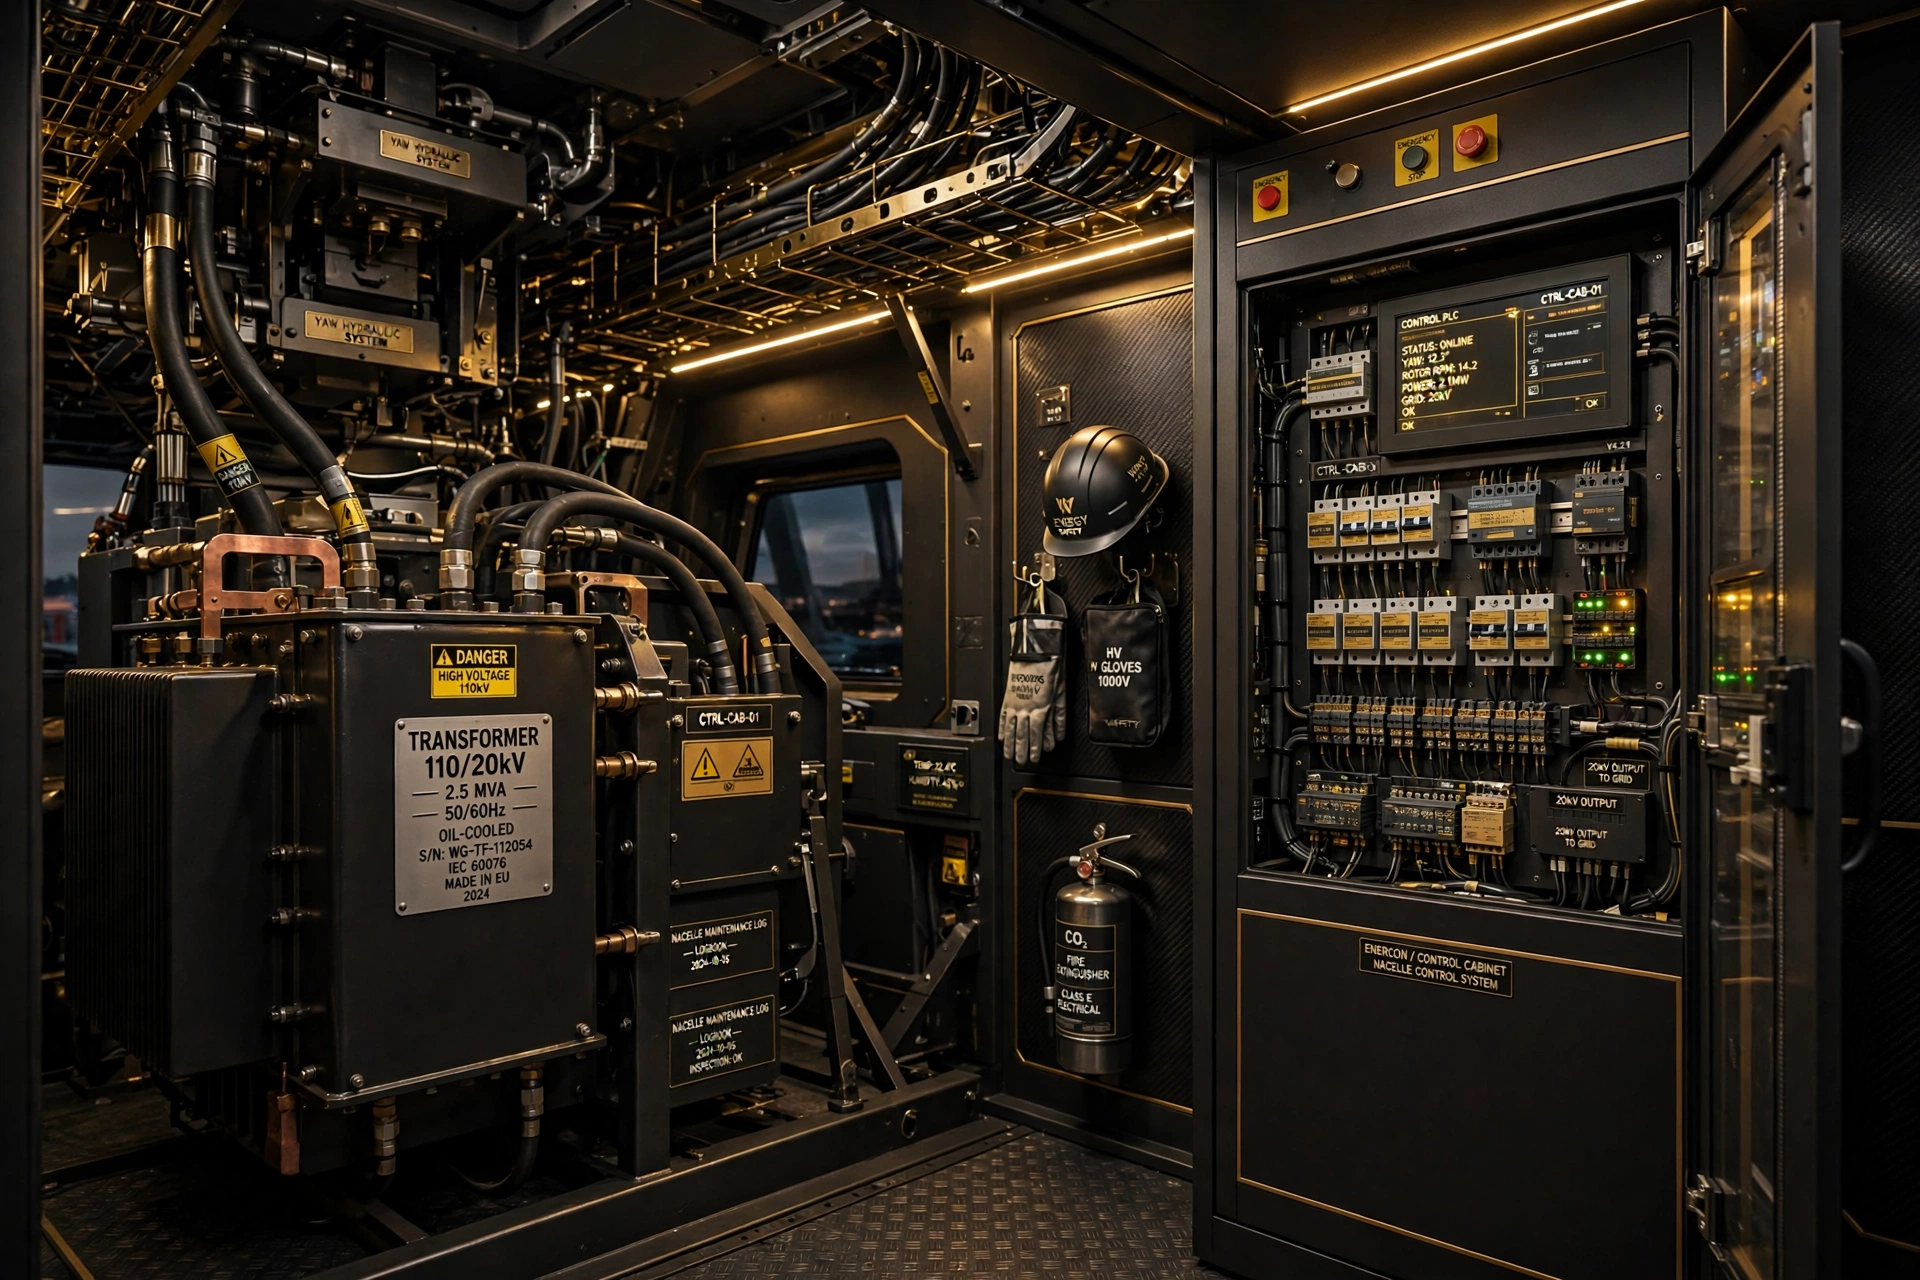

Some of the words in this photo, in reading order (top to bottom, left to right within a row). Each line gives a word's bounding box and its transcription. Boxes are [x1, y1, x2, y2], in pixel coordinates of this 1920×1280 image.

[315, 316, 337, 328] YAW
[1401, 314, 1441, 329] CONTROL
[1443, 311, 1459, 322] PLC
[1402, 342, 1438, 356] STATUS:
[1440, 335, 1474, 350] ONLINE
[1458, 361, 1478, 373] 14.2
[1401, 406, 1415, 417] OK
[1586, 399, 1599, 408] OK
[456, 649, 509, 665] DANGER
[1106, 647, 1122, 659] HV
[1101, 661, 1142, 673] GLOVES
[438, 670, 463, 682] HIGH
[466, 670, 510, 682] VOLTAGE
[1098, 675, 1131, 687] 1000V
[459, 683, 490, 694] 110kV
[699, 711, 759, 727] CTRL-CAB-01
[408, 726, 539, 751] TRANSFORMER
[425, 751, 526, 779] 110/20kV
[1611, 763, 1645, 774] OUTPUT
[1599, 773, 1611, 783] TO
[445, 784, 469, 800] 2.5
[474, 781, 507, 798] MVA
[1555, 794, 1579, 806] 20kV
[1580, 797, 1618, 809] OUTPUT
[445, 802, 506, 821] 50/60Hz
[439, 822, 514, 843] OIL-COOLED
[419, 849, 445, 863] S/N:
[449, 838, 533, 859] WG-TF-112054
[1565, 838, 1576, 847] TO
[448, 861, 467, 874] IEC
[471, 857, 507, 872] 60076
[444, 876, 477, 890] MADE
[480, 873, 492, 886] IN
[495, 871, 510, 884] EU
[463, 888, 490, 902] 2024
[671, 928, 703, 944] NACELLE
[753, 918, 768, 929] LOG
[1364, 943, 1408, 960] ENERCON
[1417, 952, 1461, 969] CONTROL
[1464, 959, 1507, 977] CABINET
[1373, 959, 1413, 975] NACELLE
[1415, 966, 1459, 983] CONTROL
[1460, 974, 1499, 991] SYSTEM
[1086, 993, 1092, 1003] E
[672, 1016, 704, 1034] NACELLE
[755, 1002, 769, 1015] LOG
